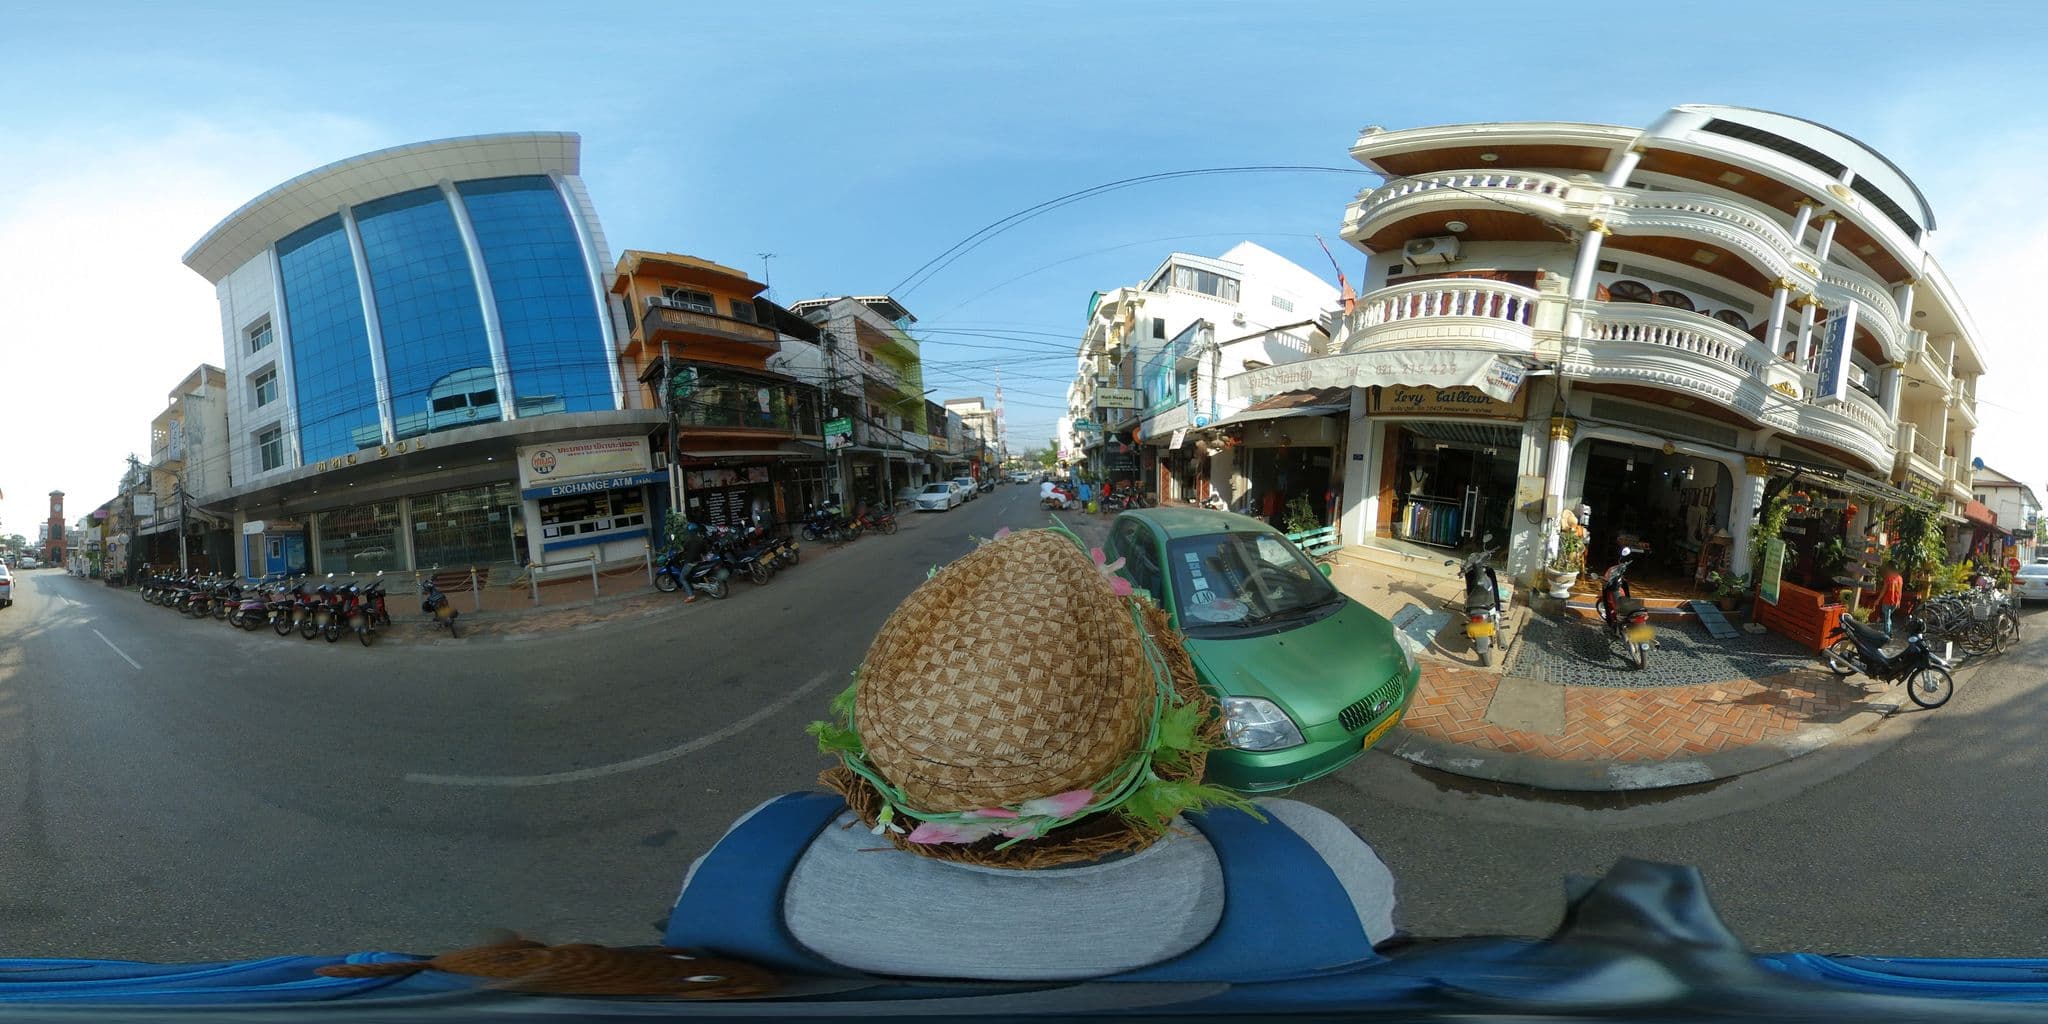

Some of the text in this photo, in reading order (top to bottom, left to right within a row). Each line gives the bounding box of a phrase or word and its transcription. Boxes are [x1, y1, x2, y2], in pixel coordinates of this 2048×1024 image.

[1818, 321, 1837, 396] HOSTEL
[1430, 363, 1457, 375] 425
[377, 438, 425, 457] BOL
[551, 481, 610, 496] EXCHANGE
[612, 477, 633, 488] ATM
